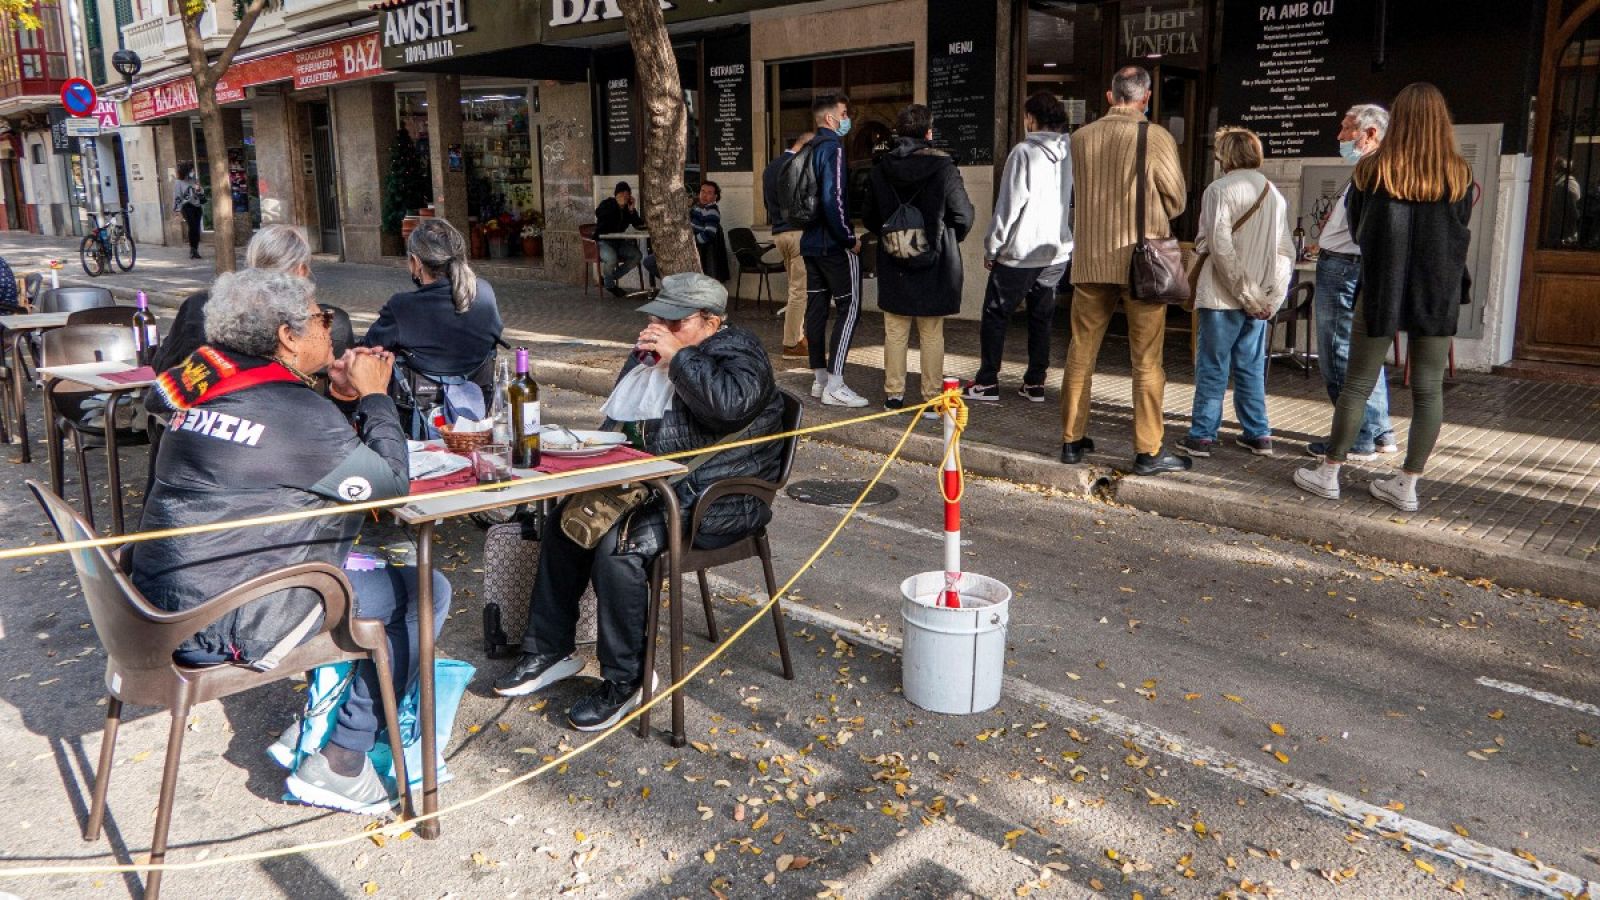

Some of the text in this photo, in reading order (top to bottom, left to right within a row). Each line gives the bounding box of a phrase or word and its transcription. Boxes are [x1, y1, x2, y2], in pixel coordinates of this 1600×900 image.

[384, 0, 468, 47] AMSTEL
[1144, 6, 1195, 31] bar
[1259, 0, 1334, 20] PA AMB OLI
[404, 39, 454, 63] 100% MALTA
[1123, 19, 1200, 58] VENECIA
[342, 39, 382, 74] BAZ
[155, 83, 186, 112] BAZAR
